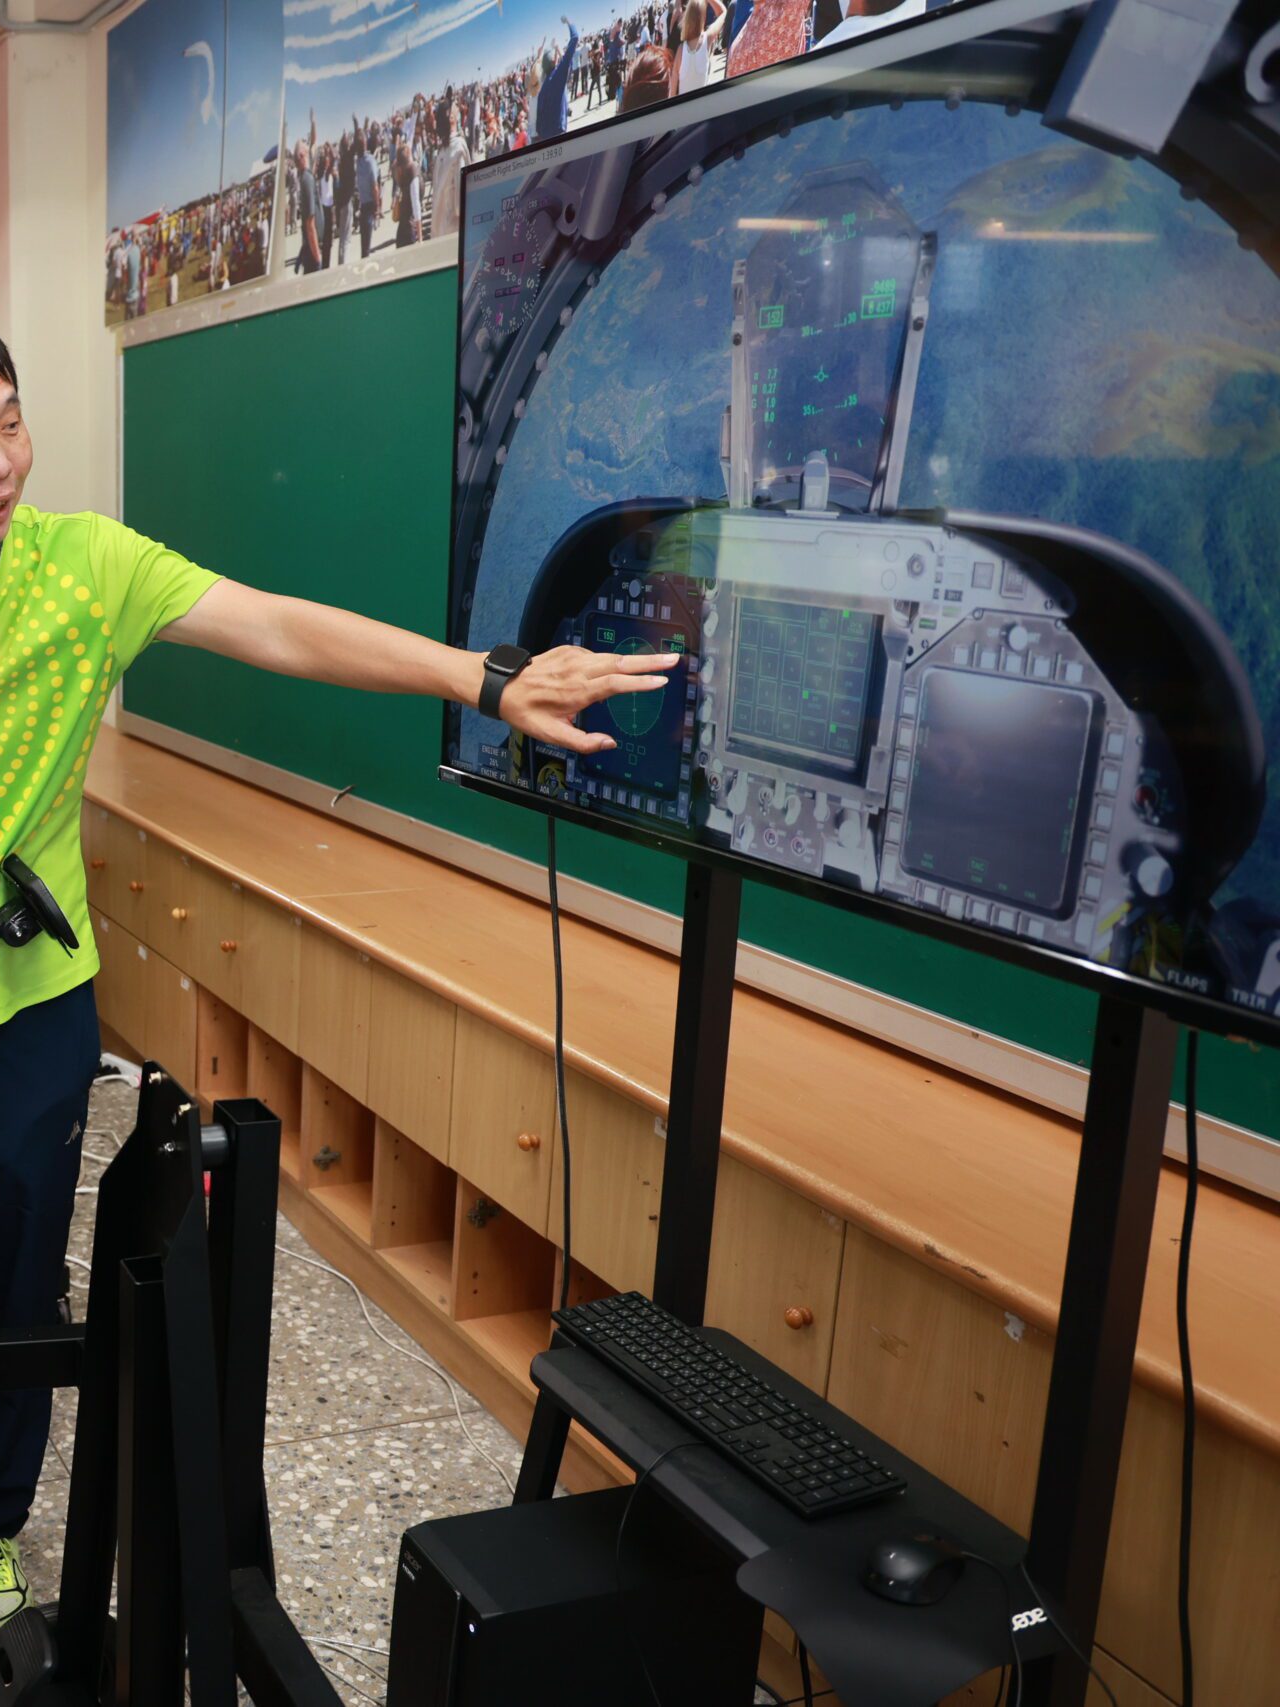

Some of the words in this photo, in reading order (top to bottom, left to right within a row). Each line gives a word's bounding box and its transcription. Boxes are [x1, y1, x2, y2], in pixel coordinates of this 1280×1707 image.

[480, 745, 499, 758] ENGINE
[480, 767, 500, 780] ENGINE
[1168, 969, 1208, 992] FLAPS
[1232, 988, 1267, 1010] TRIM
